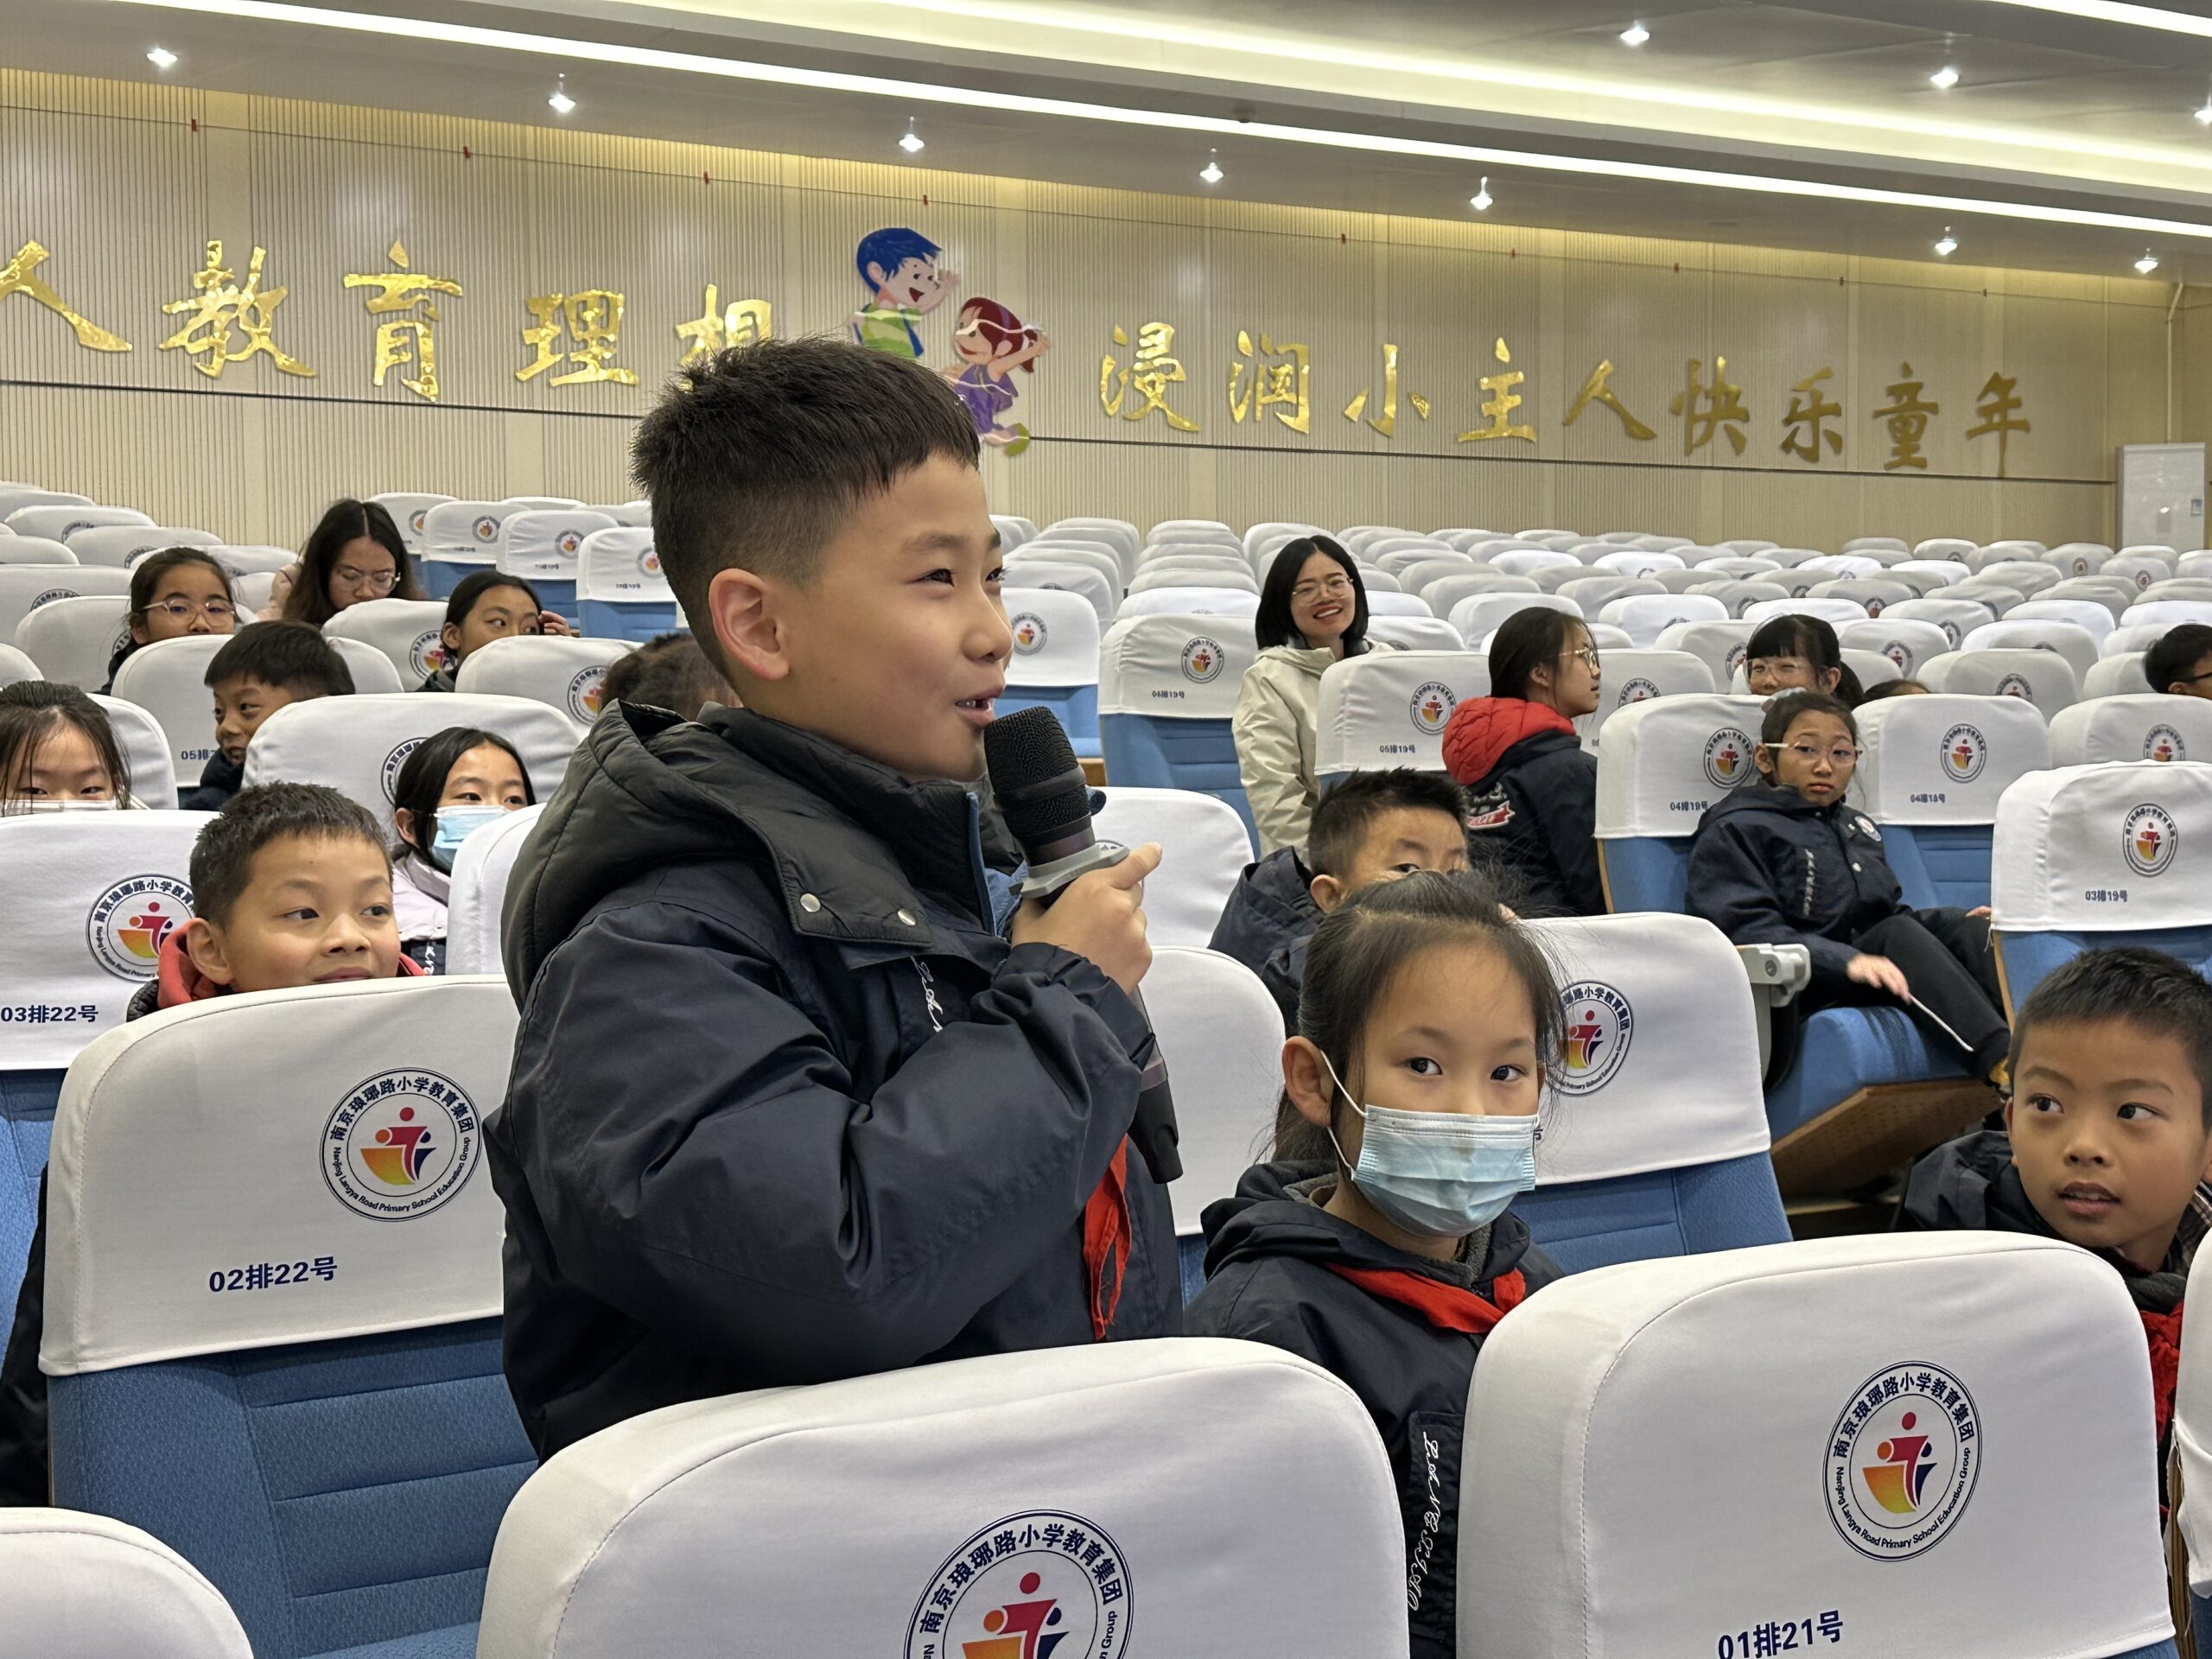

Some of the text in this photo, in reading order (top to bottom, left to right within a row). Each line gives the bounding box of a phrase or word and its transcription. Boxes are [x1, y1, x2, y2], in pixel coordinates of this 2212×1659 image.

[1097, 321, 2031, 477] 浸润小主人快乐童年
[0, 1004, 99, 1024] 03排22号
[329, 1076, 475, 1141] 南京琅琊路小学教育集团
[459, 1136, 472, 1161] Group
[208, 1255, 338, 1293] 02排22号
[1833, 1371, 1975, 1459] 南京琅琊路小学教育集团
[1912, 1520, 1940, 1544] School
[1959, 1447, 1971, 1479] Group
[918, 1522, 1123, 1634] 南京琅琊路小学教育集团
[1101, 1610, 1118, 1649] Group
[1717, 1609, 1844, 1659] 01排21号
